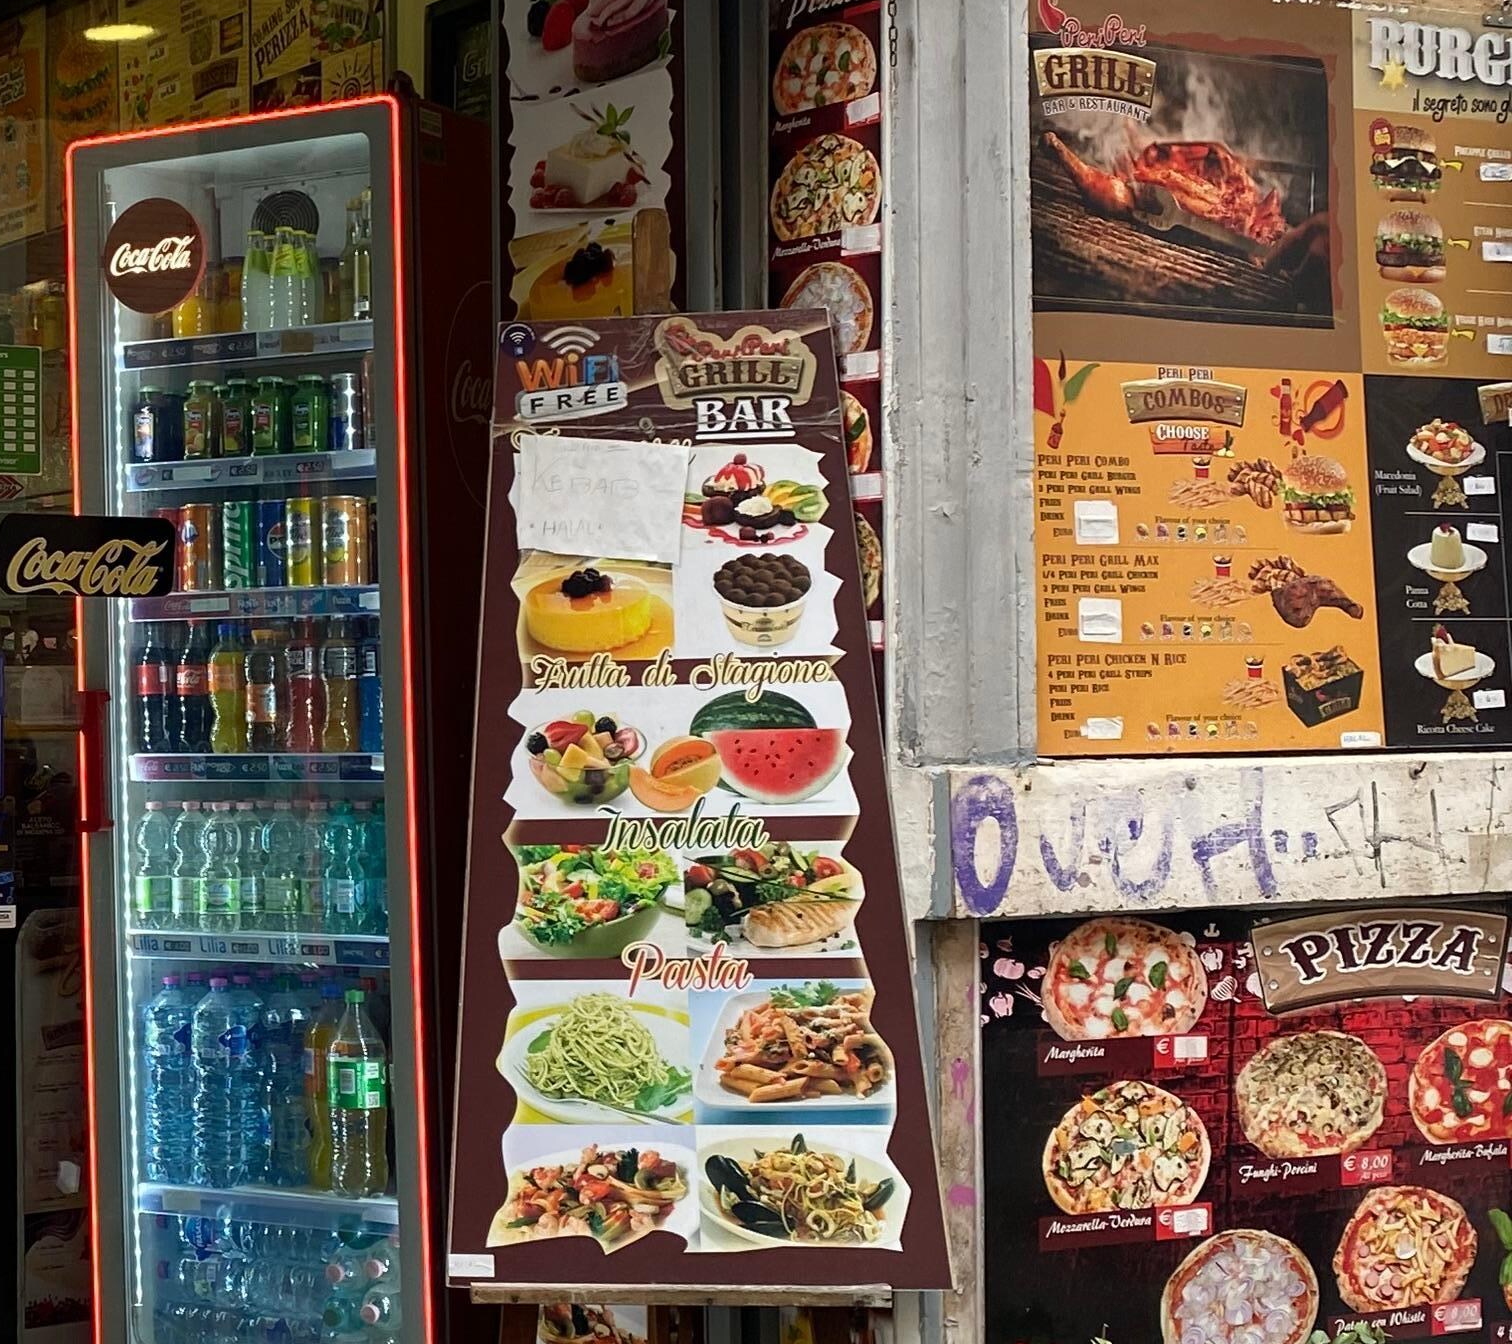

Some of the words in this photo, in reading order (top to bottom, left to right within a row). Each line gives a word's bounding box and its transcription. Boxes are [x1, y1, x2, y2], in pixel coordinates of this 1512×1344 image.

[1365, 15, 1512, 86] BURG
[1043, 54, 1148, 97] GRILL
[1043, 100, 1067, 116] BAR
[1069, 99, 1076, 110] &
[1079, 97, 1150, 122] RESTAURANT
[1423, 94, 1468, 122] segreto
[1471, 98, 1497, 112] sono
[110, 234, 197, 277] Coca-Cola
[679, 361, 791, 388] GRILL
[1158, 367, 1182, 379] PERI
[1189, 368, 1213, 380] PERI
[530, 386, 619, 414] FREE
[1143, 389, 1225, 414] COMBOS
[696, 396, 793, 432] BAR
[1156, 424, 1210, 441] CHOOSE
[1038, 455, 1062, 466] PERI
[1067, 455, 1090, 466] PERI
[1094, 456, 1130, 467] COMBO
[6, 536, 168, 596] Coca-Cola
[1042, 555, 1067, 566] PERI
[1071, 555, 1095, 566] PERI
[1100, 555, 1129, 566] GRILL
[1134, 555, 1159, 566] MAX
[1048, 654, 1071, 666] PERI
[1076, 654, 1100, 665] PERI
[1105, 654, 1146, 665] CHICKEN
[1151, 654, 1160, 665] N
[1164, 654, 1187, 665] RICE
[530, 653, 630, 693] Frutta
[642, 648, 676, 687] di
[690, 651, 831, 703] Stagione
[597, 797, 769, 853] Insalata
[199, 937, 226, 953] Lilia
[1282, 920, 1485, 986] PIZZA
[621, 941, 754, 997] Pasta
[1044, 1046, 1105, 1063] Margherita
[1344, 1155, 1356, 1171] €
